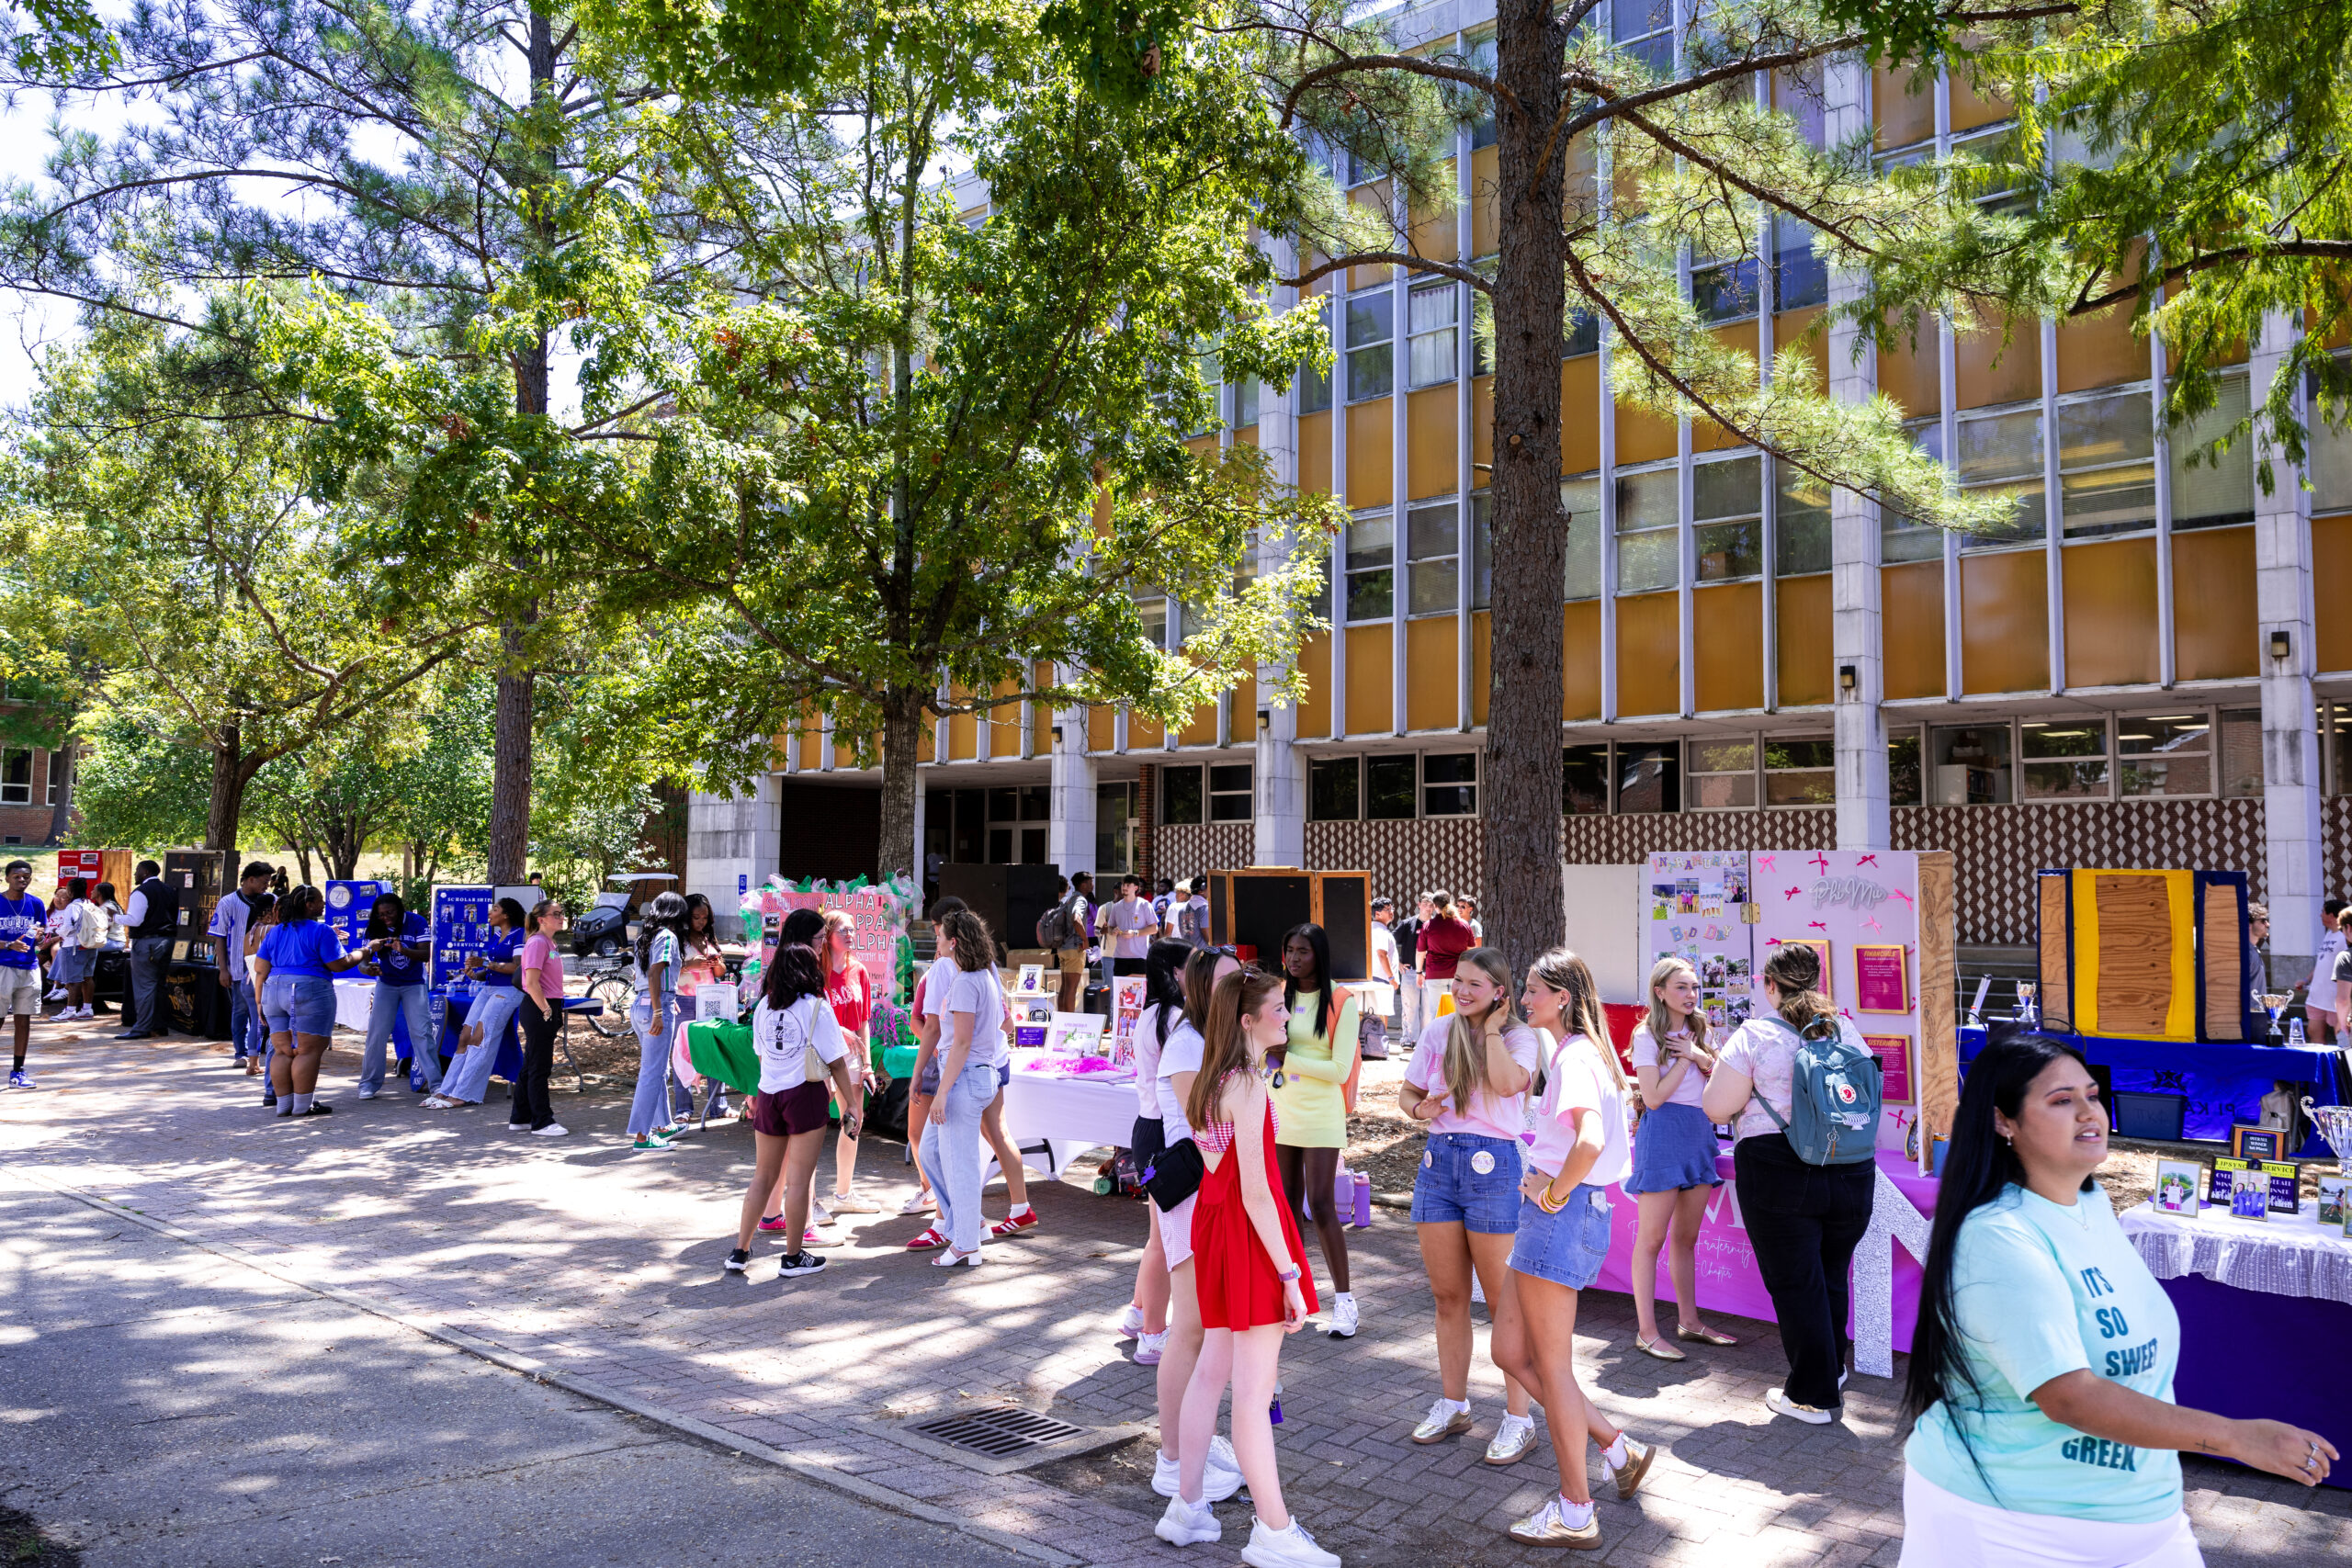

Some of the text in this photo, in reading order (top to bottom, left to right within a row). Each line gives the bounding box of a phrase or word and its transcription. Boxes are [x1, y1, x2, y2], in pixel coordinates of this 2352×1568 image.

[1652, 853, 1747, 874] INTRAMURALS
[198, 895, 220, 908] ALPH
[1812, 878, 1883, 908] Phi Mu
[765, 896, 822, 911] SCHOLARSHIP
[824, 894, 875, 911] ALPHA
[856, 913, 885, 931] PPA
[1668, 923, 1733, 942] BID DAY
[1867, 1038, 1903, 1047] SISTERHOOD
[2262, 1165, 2294, 1175] SERVICE
[1695, 1229, 1754, 1269] Fraternity
[2096, 1306, 2129, 1338] SO
[2062, 1436, 2137, 1472] GREEK
